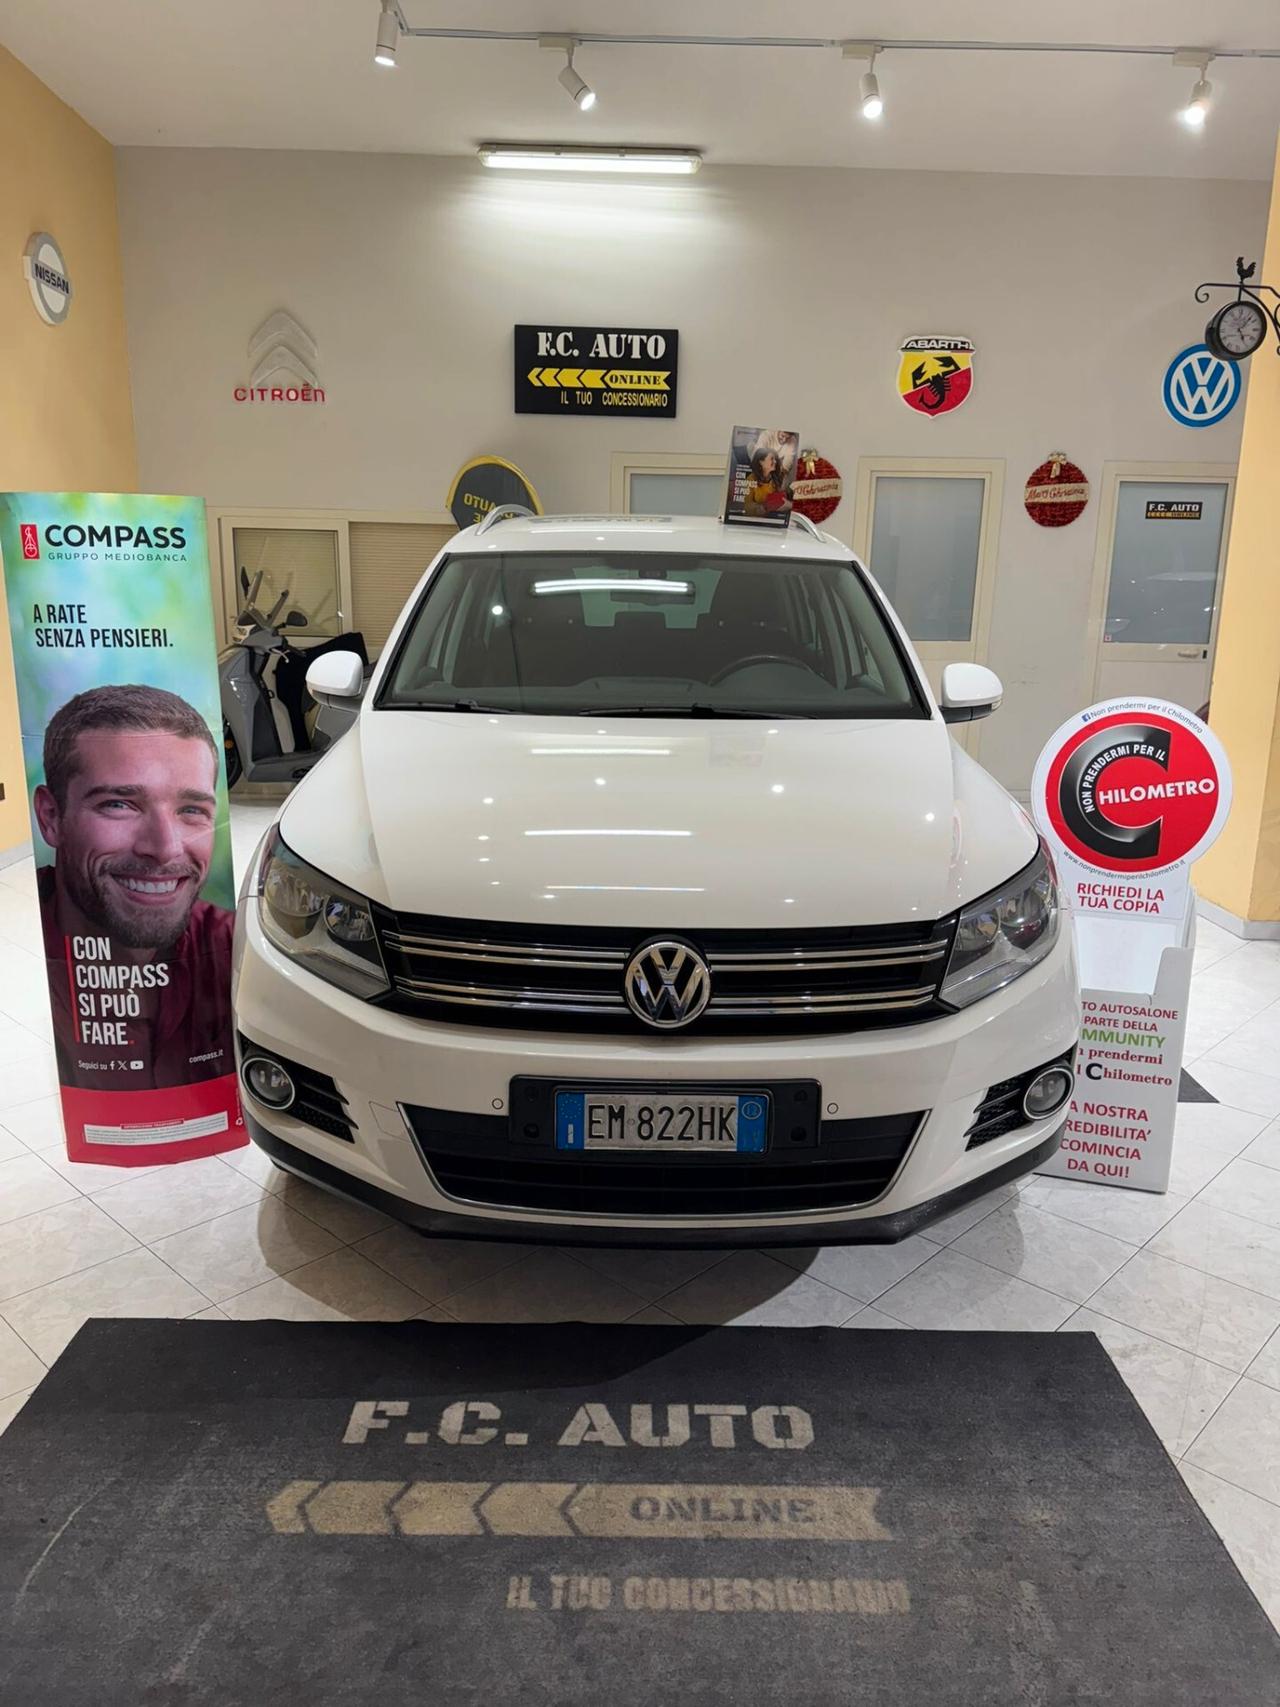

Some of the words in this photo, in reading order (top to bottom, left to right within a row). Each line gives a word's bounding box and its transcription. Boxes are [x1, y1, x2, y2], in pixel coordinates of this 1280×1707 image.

[34, 263, 70, 294] NISSAN
[537, 331, 580, 357] F.C.
[589, 333, 667, 360] AUTO
[906, 340, 969, 349] ABARTH
[609, 373, 662, 386] ONLINE
[560, 391, 569, 405] IL
[576, 391, 593, 405] TUO
[602, 392, 668, 408] CONCESSIONARIO
[1170, 503, 1200, 512] AUTO
[45, 524, 187, 549] COMPASS
[48, 552, 99, 561] GRUPPO
[105, 552, 187, 562] MEDIOBANCA
[33, 604, 43, 624] A
[46, 604, 88, 624] RATE
[35, 628, 86, 648] SENZA
[90, 628, 174, 648] PENSIERI.
[1090, 708, 1106, 719] Non
[1107, 701, 1147, 713] prendermi
[1147, 703, 1161, 712] per
[1167, 707, 1204, 734] Chilometro
[1133, 744, 1155, 756] PER
[1155, 748, 1167, 762] IL
[1082, 744, 1130, 788] PRENDERMI
[1081, 790, 1096, 814] NON
[1076, 883, 1143, 899] RICHIEDI
[1146, 887, 1165, 902] LA
[1078, 896, 1109, 910] TUA
[1113, 899, 1160, 914] COPIA
[73, 935, 112, 960] CON
[75, 963, 170, 989] COMPASS
[78, 993, 96, 1017] SI
[100, 989, 141, 1017] PUÒ
[1099, 1003, 1179, 1020] AUTOSALONE
[1083, 1016, 1120, 1028] PARTE
[1122, 1020, 1158, 1032] DELLA
[1081, 1028, 1166, 1048] MMUNITY
[78, 1060, 98, 1071] Seguici
[188, 1048, 224, 1064] compass.it
[1088, 1048, 1163, 1065] prendermi
[1085, 1062, 1173, 1086] Chilometro
[1083, 1102, 1149, 1122] NOSTRA
[587, 1104, 626, 1140] EM
[637, 1105, 737, 1142] 822HK
[1065, 1119, 1152, 1142] REDIBILITA'
[1060, 1138, 1141, 1160] COMINCIA
[1067, 1158, 1089, 1172] DA
[1094, 1161, 1130, 1178] QUI!
[342, 1400, 529, 1446] F.C.
[557, 1402, 815, 1450] AUTO
[628, 1496, 820, 1528] ONLINE
[506, 1575, 537, 1611] IL
[550, 1573, 612, 1612] TUO
